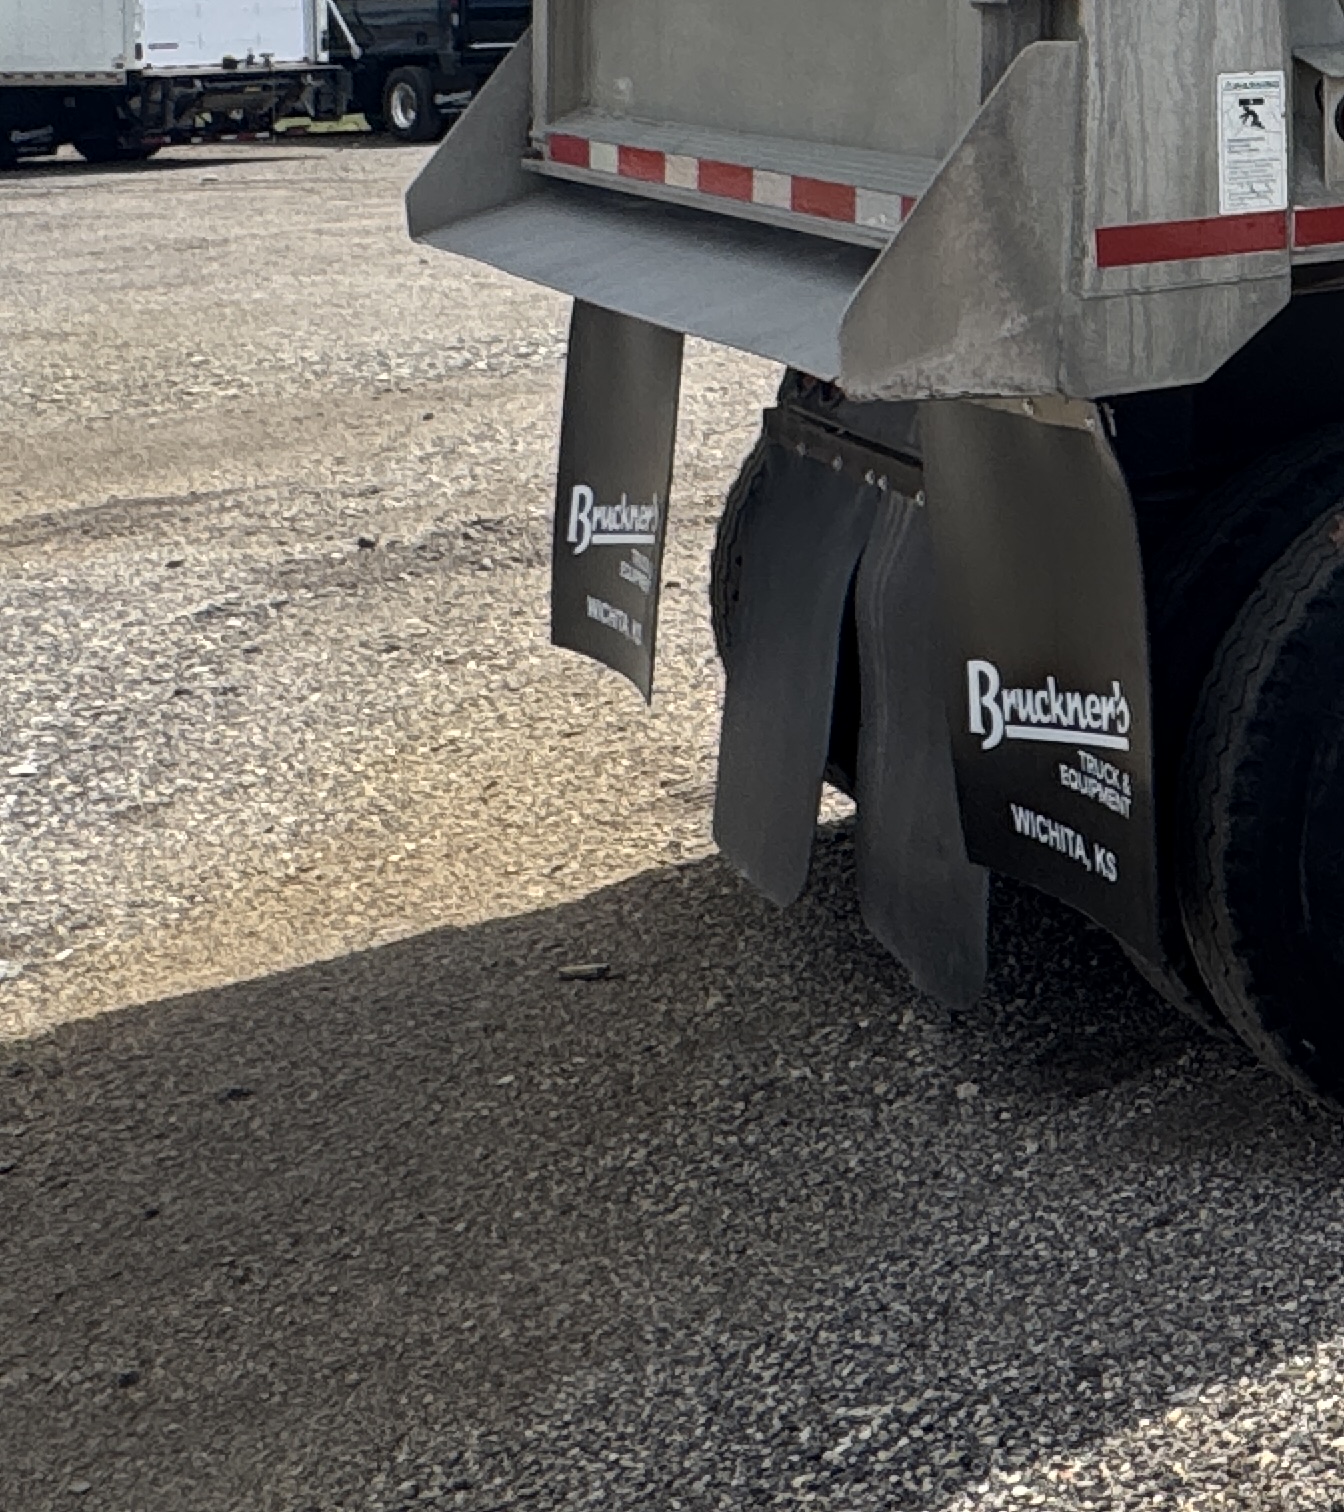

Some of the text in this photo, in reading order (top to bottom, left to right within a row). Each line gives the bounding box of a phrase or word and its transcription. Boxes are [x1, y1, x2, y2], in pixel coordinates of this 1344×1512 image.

[966, 659, 1130, 750] Bruckner's
[1059, 763, 1132, 820] EQUIPMENT
[1077, 749, 1120, 790] TRUCK
[1010, 802, 1118, 883] WICHITA, KS
